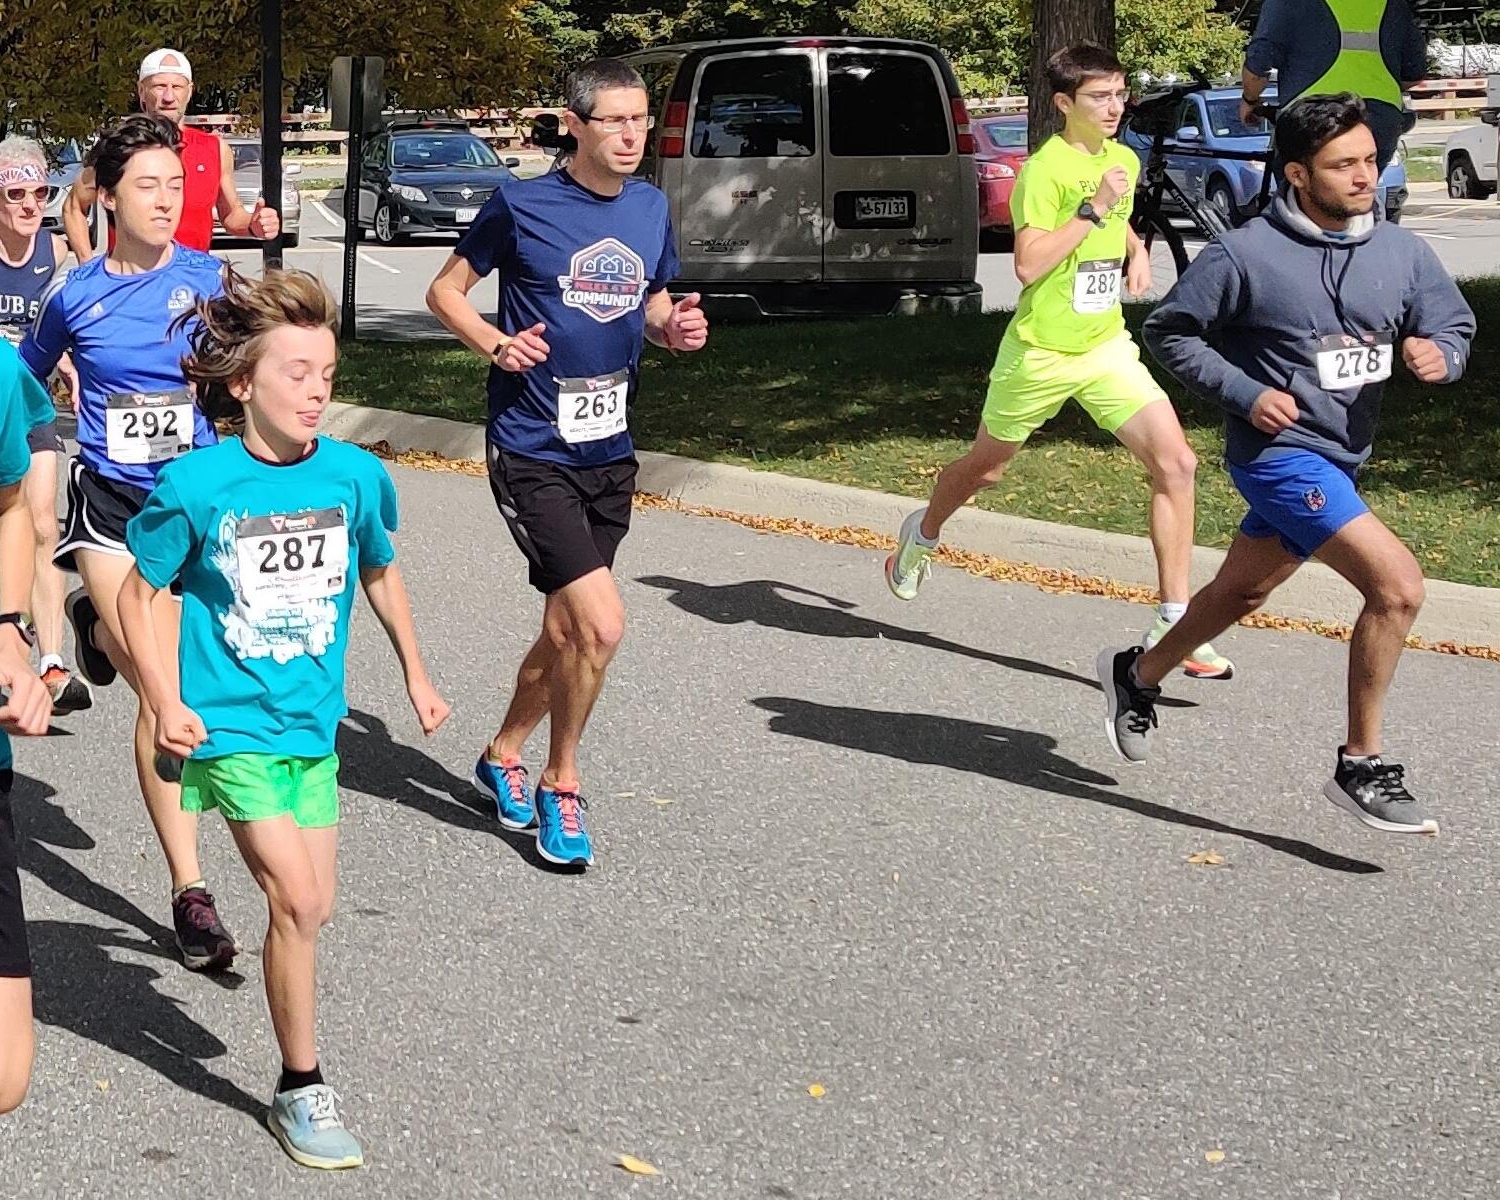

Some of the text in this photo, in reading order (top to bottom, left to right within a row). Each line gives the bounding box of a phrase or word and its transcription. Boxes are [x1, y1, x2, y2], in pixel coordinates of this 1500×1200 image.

[874, 201, 906, 215] 67133
[1086, 272, 1116, 295] 282
[28, 301, 39, 319] 5
[566, 290, 640, 307] COMMUNITY
[1335, 348, 1382, 379] 278
[574, 390, 618, 420] 263
[122, 410, 178, 439] 292
[258, 534, 326, 573] 287
